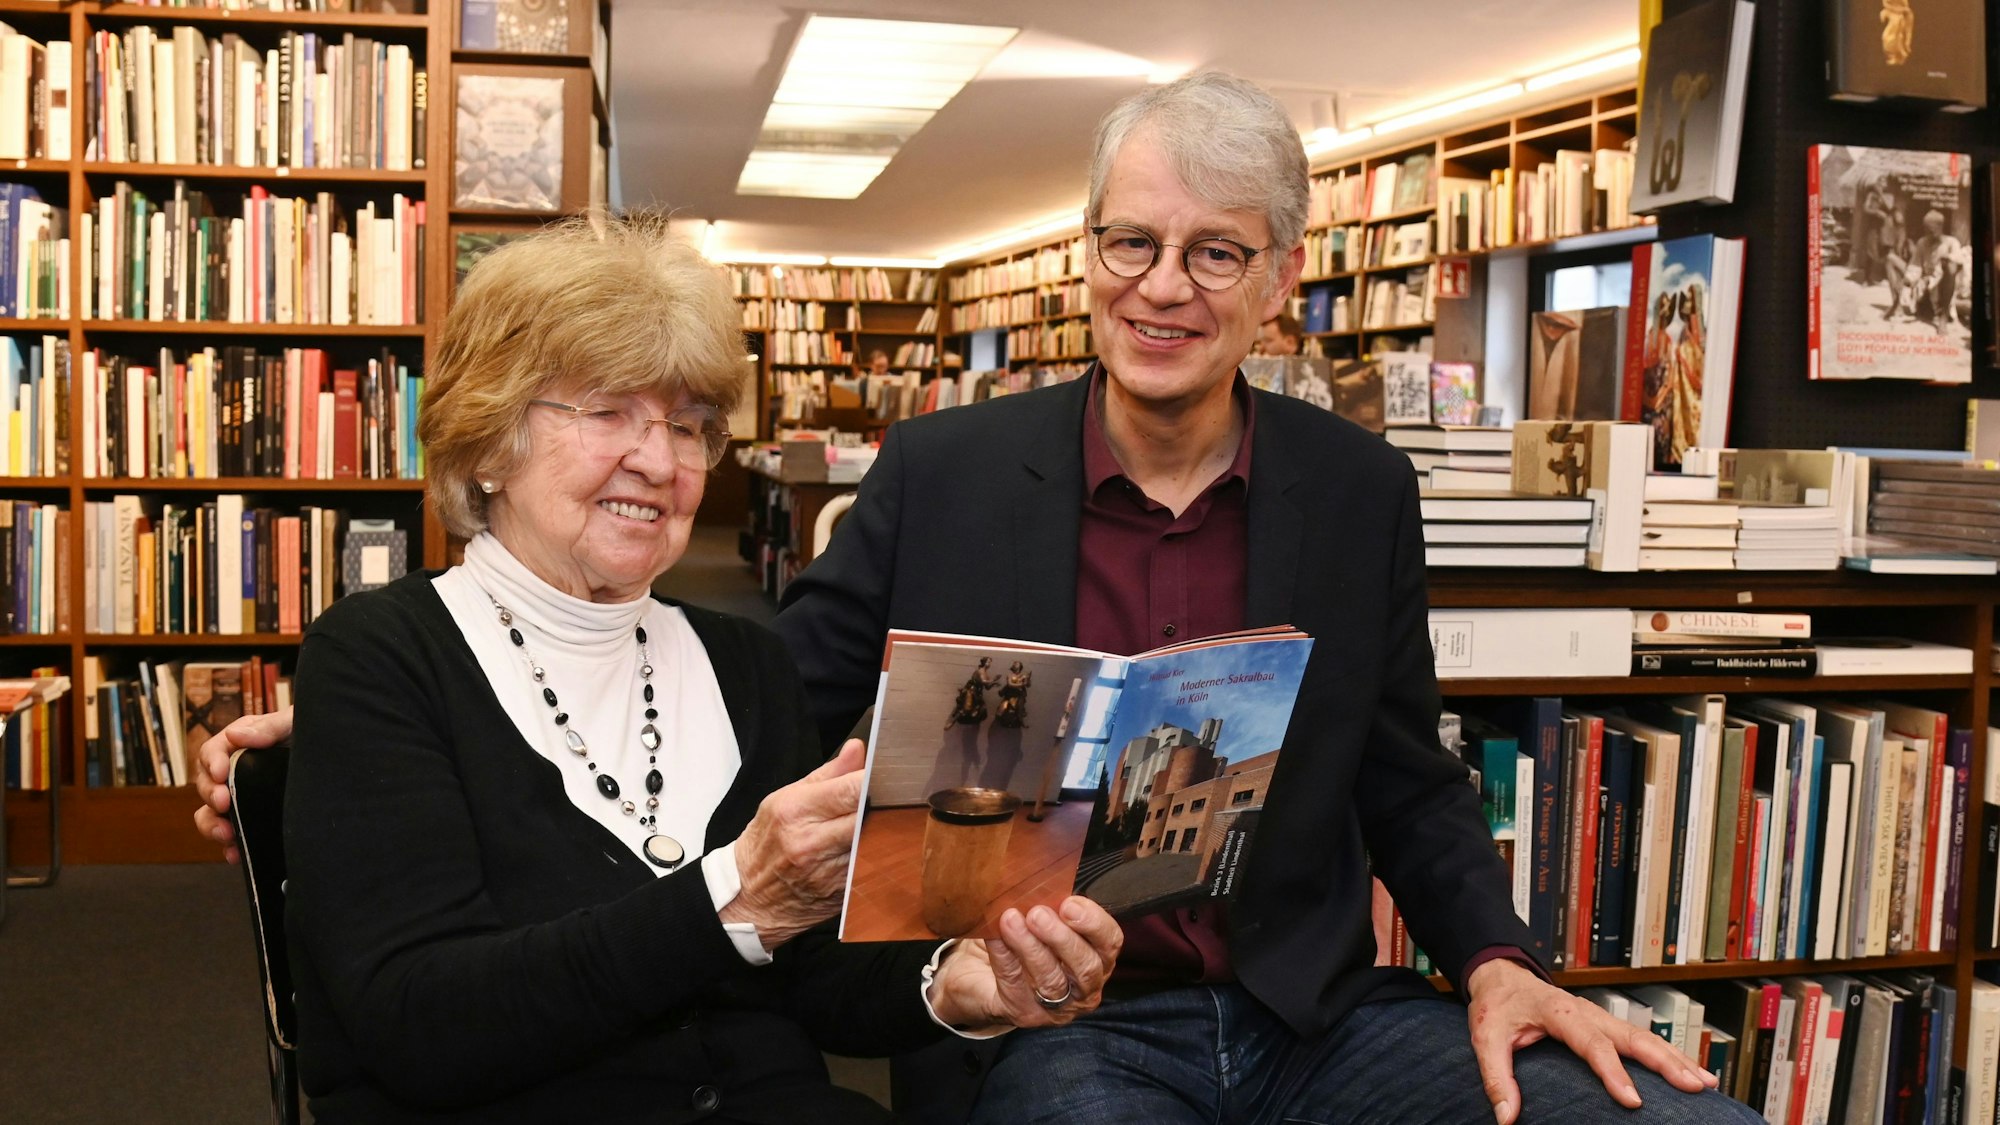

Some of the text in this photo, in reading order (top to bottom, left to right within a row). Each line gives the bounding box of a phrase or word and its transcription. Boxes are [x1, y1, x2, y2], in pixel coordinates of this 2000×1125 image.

[119, 507, 131, 587] TANZANIA
[1680, 613, 1760, 628] CHINESE
[1173, 669, 1185, 678] Kier
[1769, 658, 1807, 668] Bilderwelt
[1180, 671, 1275, 692] Moderner Sakralbau
[1176, 691, 1209, 706] in Köln
[1576, 791, 1584, 813] HOW
[1882, 785, 1894, 840] THIRTY-SIX
[1576, 815, 1583, 826] TO
[1736, 789, 1750, 845] Confucius
[1954, 811, 1965, 844] WORLD
[1538, 782, 1554, 893] A Passage to Asia
[1574, 828, 1582, 849] READ
[1611, 802, 1622, 868] CLEMENCEAU
[1988, 825, 1998, 853] Tibet
[1223, 831, 1246, 895] Stadtteil Lindenthal
[1571, 851, 1580, 892] BUDDHIST
[1878, 845, 1889, 878] VIEWS
[1211, 877, 1222, 896] Bezirk
[1799, 996, 1818, 1076] Performing Images
[1984, 1025, 1996, 1052] The
[1982, 1056, 1993, 1087] Baur
